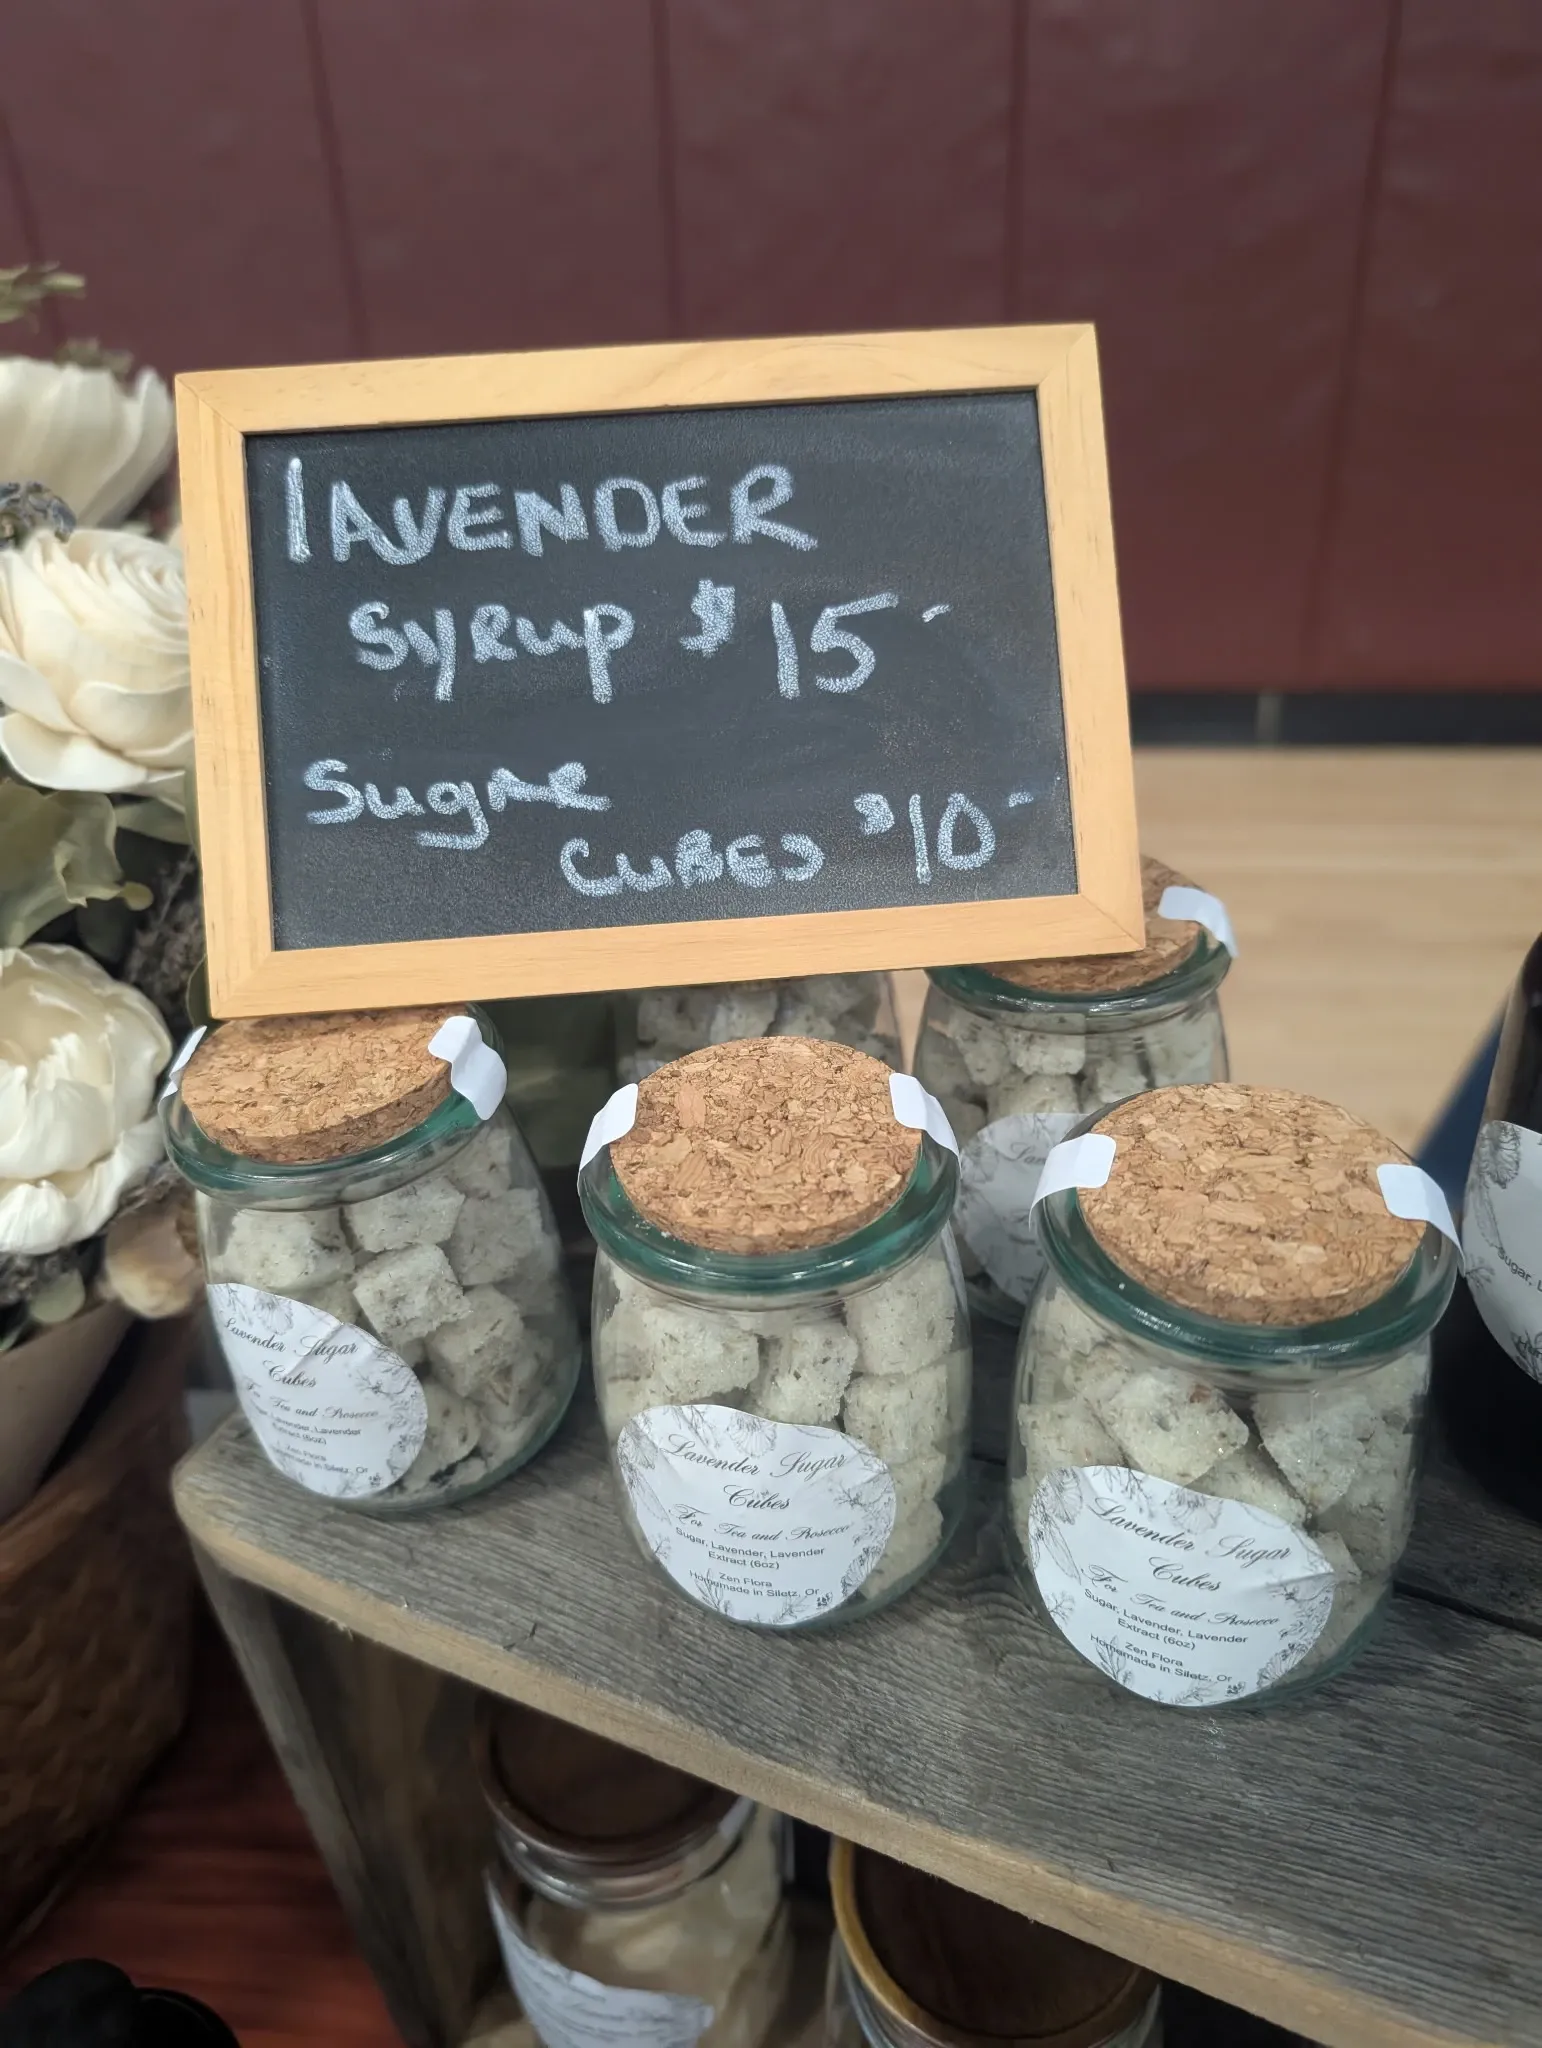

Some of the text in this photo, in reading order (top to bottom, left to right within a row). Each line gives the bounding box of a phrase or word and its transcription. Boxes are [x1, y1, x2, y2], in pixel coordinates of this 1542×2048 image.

[224, 1317, 358, 1364] Lavender Sugar
[262, 1360, 317, 1388] Cubes
[295, 1407, 319, 1418] and
[659, 1434, 847, 1481] Lavender Sugar
[723, 1484, 790, 1510] Cubes
[668, 1503, 854, 1541] For Tea and Prosecco
[1087, 1497, 1292, 1569] Lavender Sugar
[675, 1526, 825, 1559] Sugar, Lavender, Lavender
[708, 1551, 780, 1570] Extract (6oz)
[1149, 1556, 1221, 1592] Cubes
[718, 1571, 773, 1588] Zen Flora
[753, 1588, 763, 1597] in
[805, 1588, 820, 1597] Or
[1081, 1564, 1280, 1627] For Tea and Prosecco
[1084, 1588, 1249, 1644] Sugar, Lavender, Lavender
[1117, 1618, 1196, 1651] Extract (6oz)
[1090, 1633, 1157, 1669] Homemade
[1159, 1665, 1171, 1673] in
[1216, 1674, 1233, 1683] Or
[1125, 1642, 1183, 1667] Zen Flora
